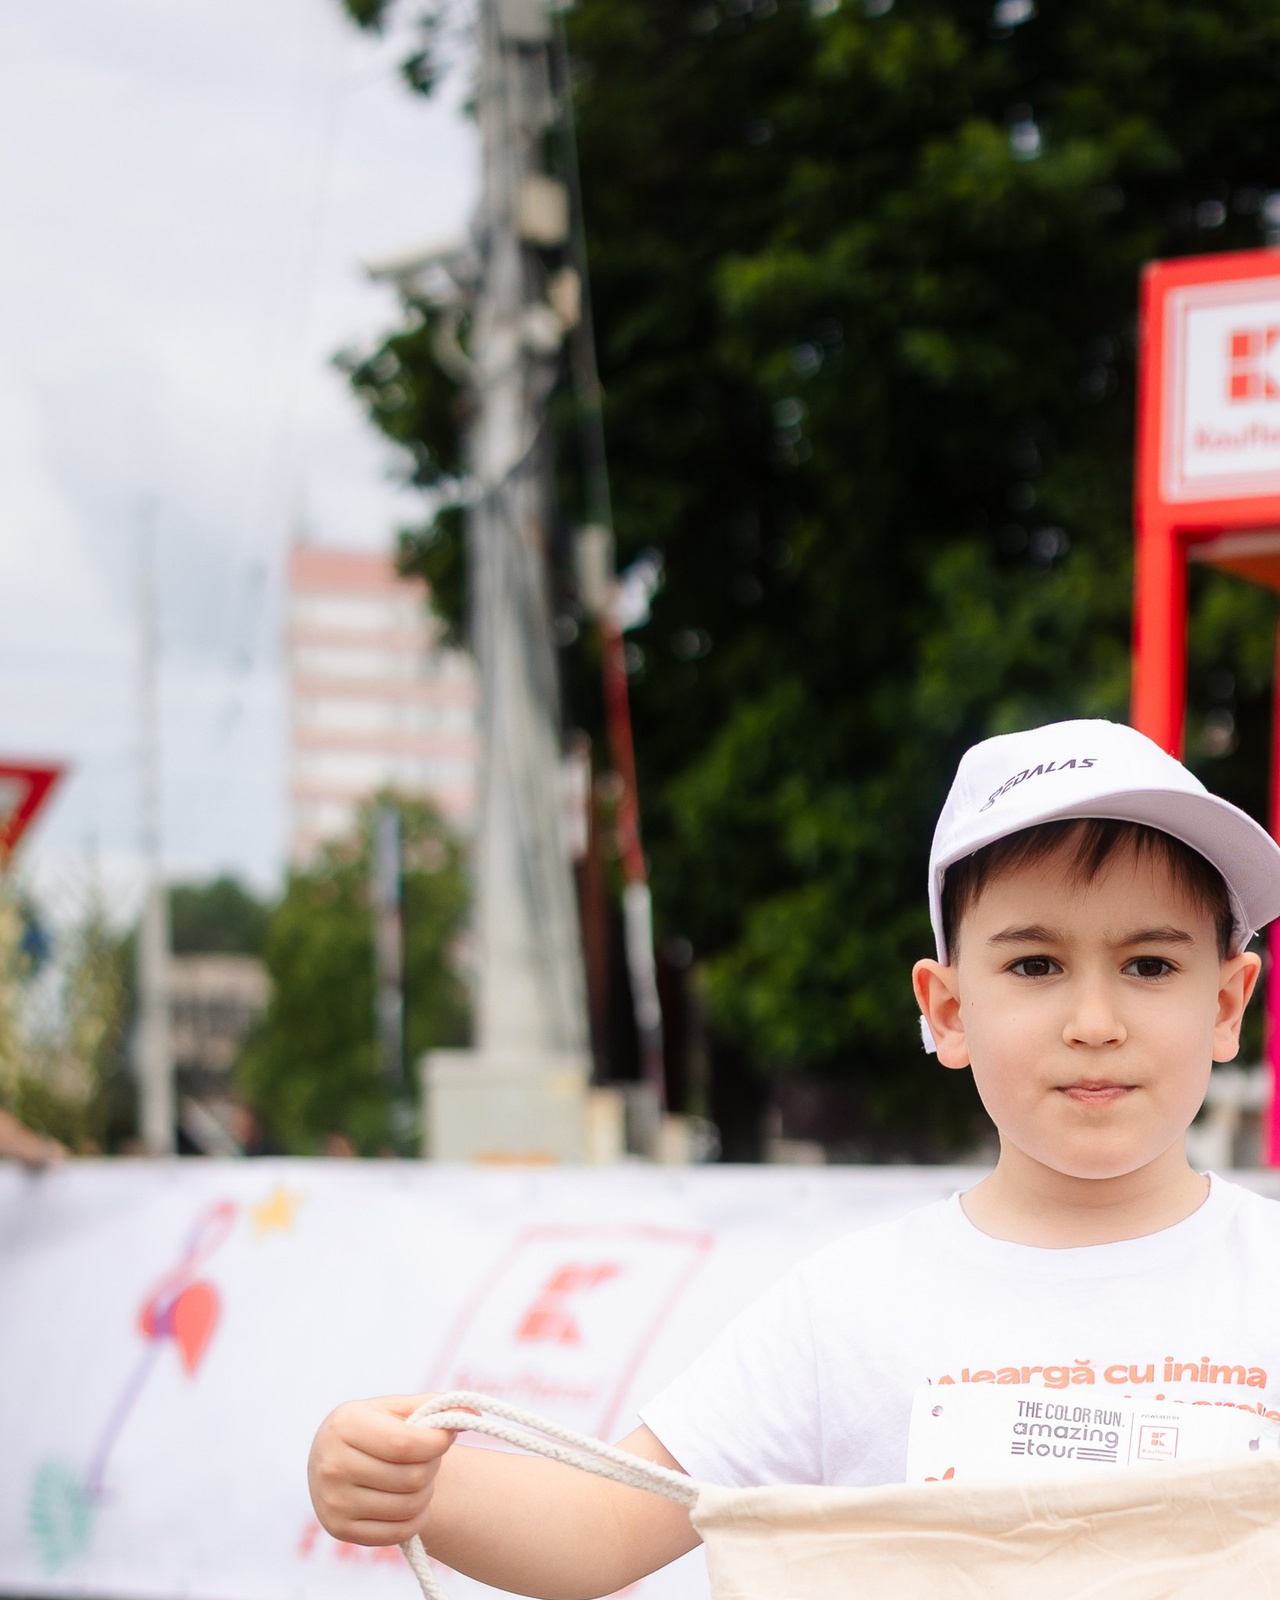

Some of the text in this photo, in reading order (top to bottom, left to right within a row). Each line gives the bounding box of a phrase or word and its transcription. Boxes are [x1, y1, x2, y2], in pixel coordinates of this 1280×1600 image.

[1103, 1364, 1155, 1384] cu
[1163, 1356, 1267, 1389] inima
[1017, 1400, 1043, 1419] THE
[1045, 1403, 1091, 1424] COLOR
[1013, 1422, 1119, 1449] amazing
[1027, 1439, 1075, 1459] tour
